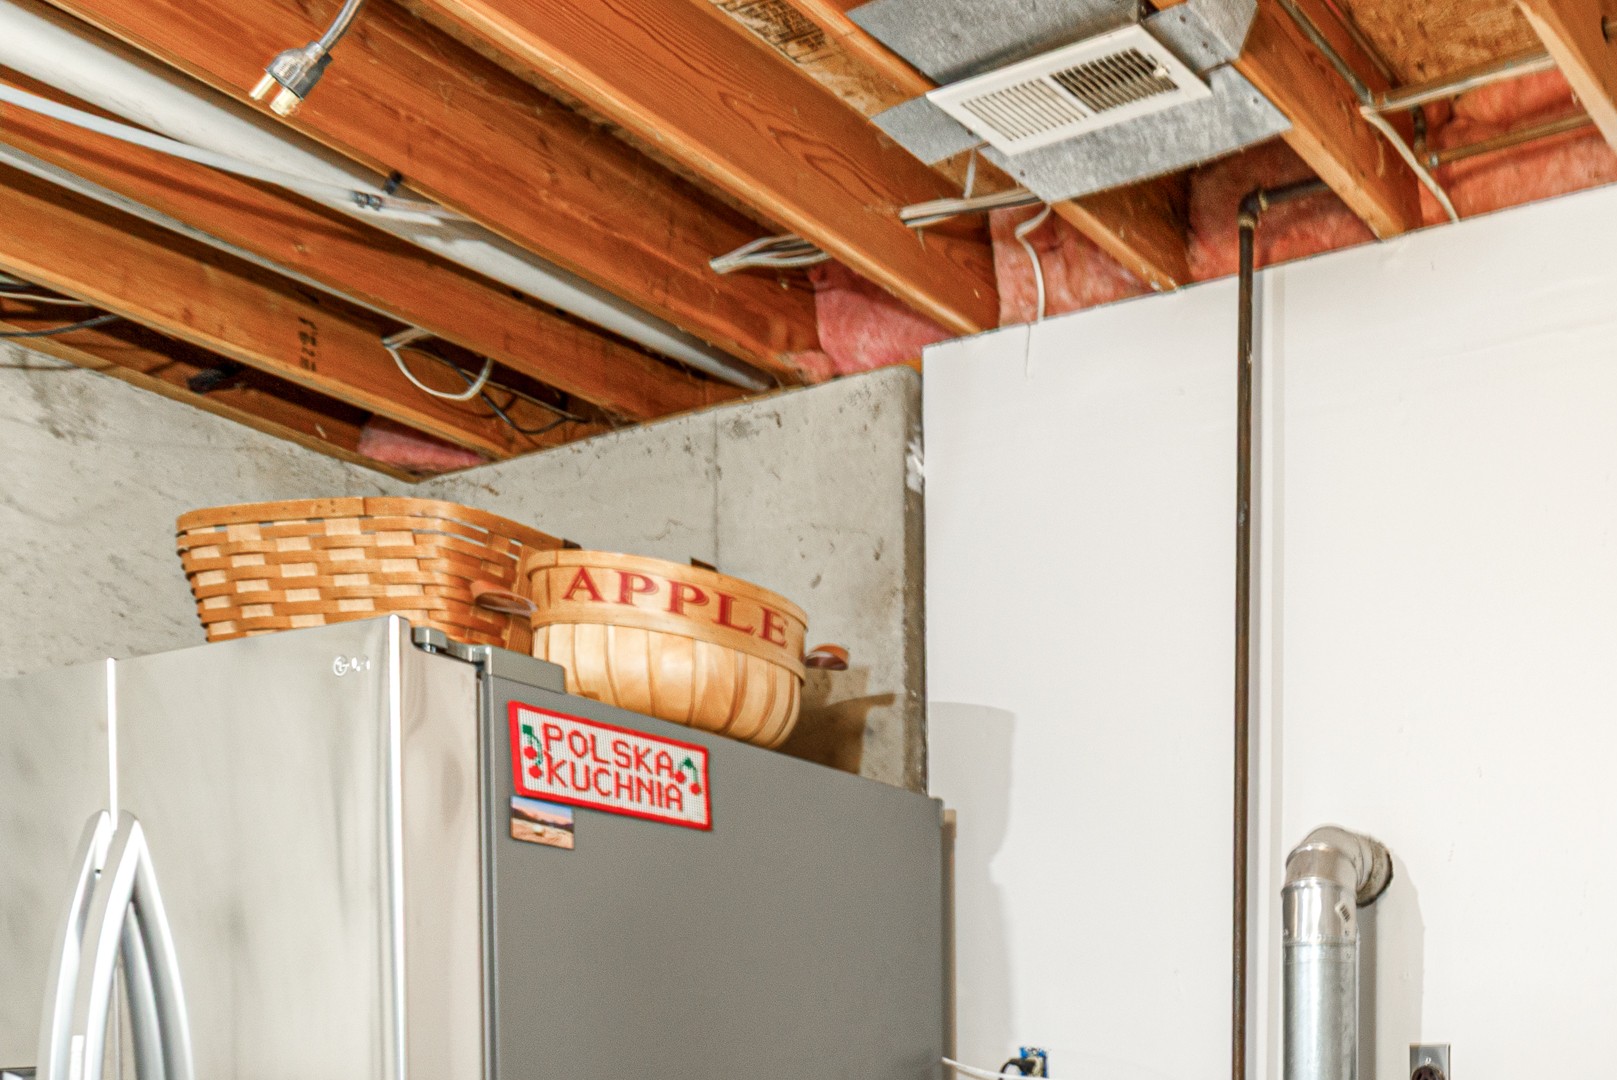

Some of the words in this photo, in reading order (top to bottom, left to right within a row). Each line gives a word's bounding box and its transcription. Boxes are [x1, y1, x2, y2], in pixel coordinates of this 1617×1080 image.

[562, 566, 789, 649] APPLE
[541, 723, 675, 778] POLSKA
[544, 750, 683, 812] KUCHNIA
